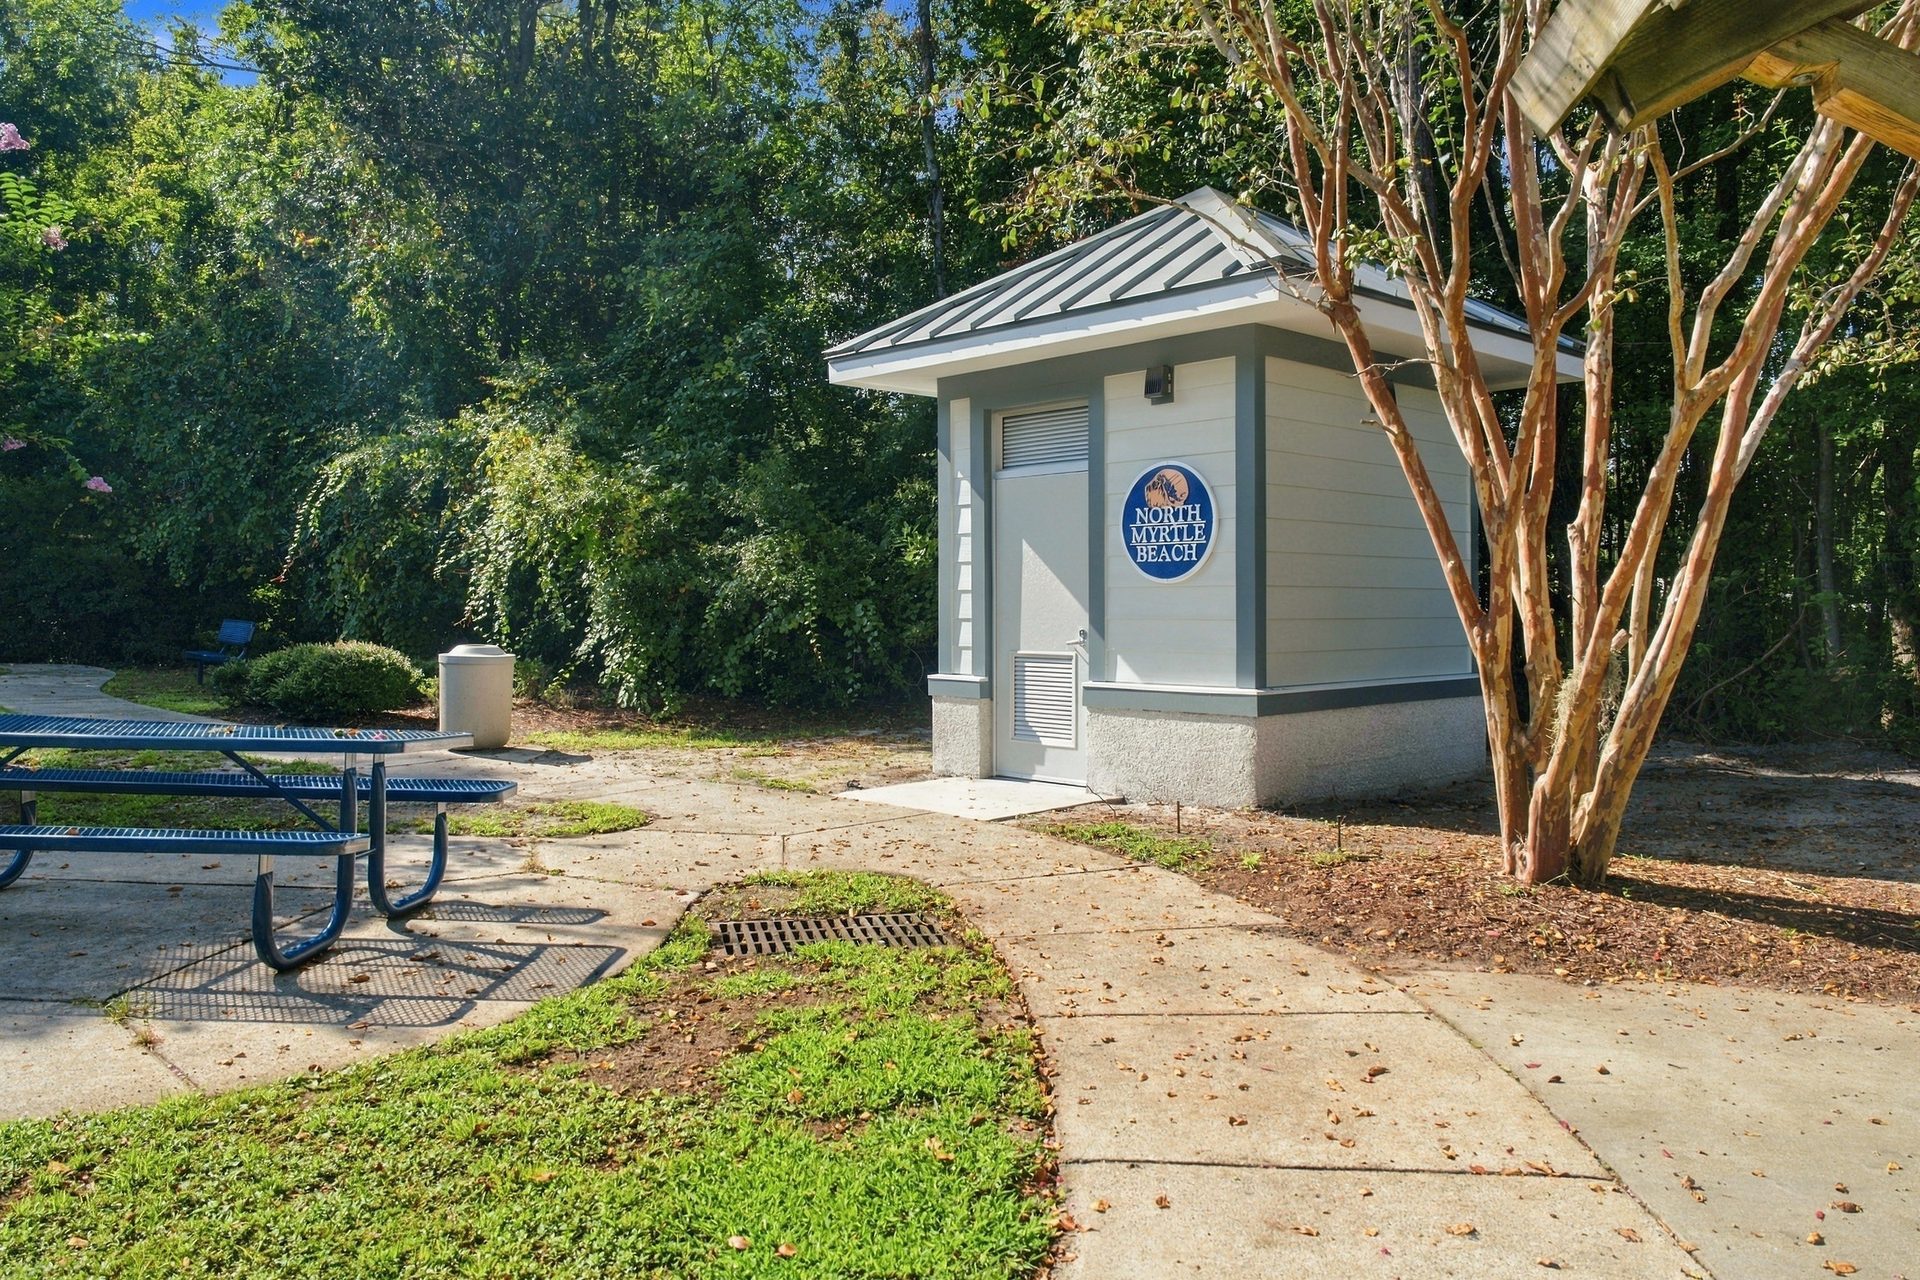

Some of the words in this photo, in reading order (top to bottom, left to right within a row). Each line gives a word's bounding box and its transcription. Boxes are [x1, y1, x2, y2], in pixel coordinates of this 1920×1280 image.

[1135, 504, 1201, 525] NORTH
[1131, 523, 1206, 543] MYRTLE
[1136, 544, 1197, 562] BEACH
